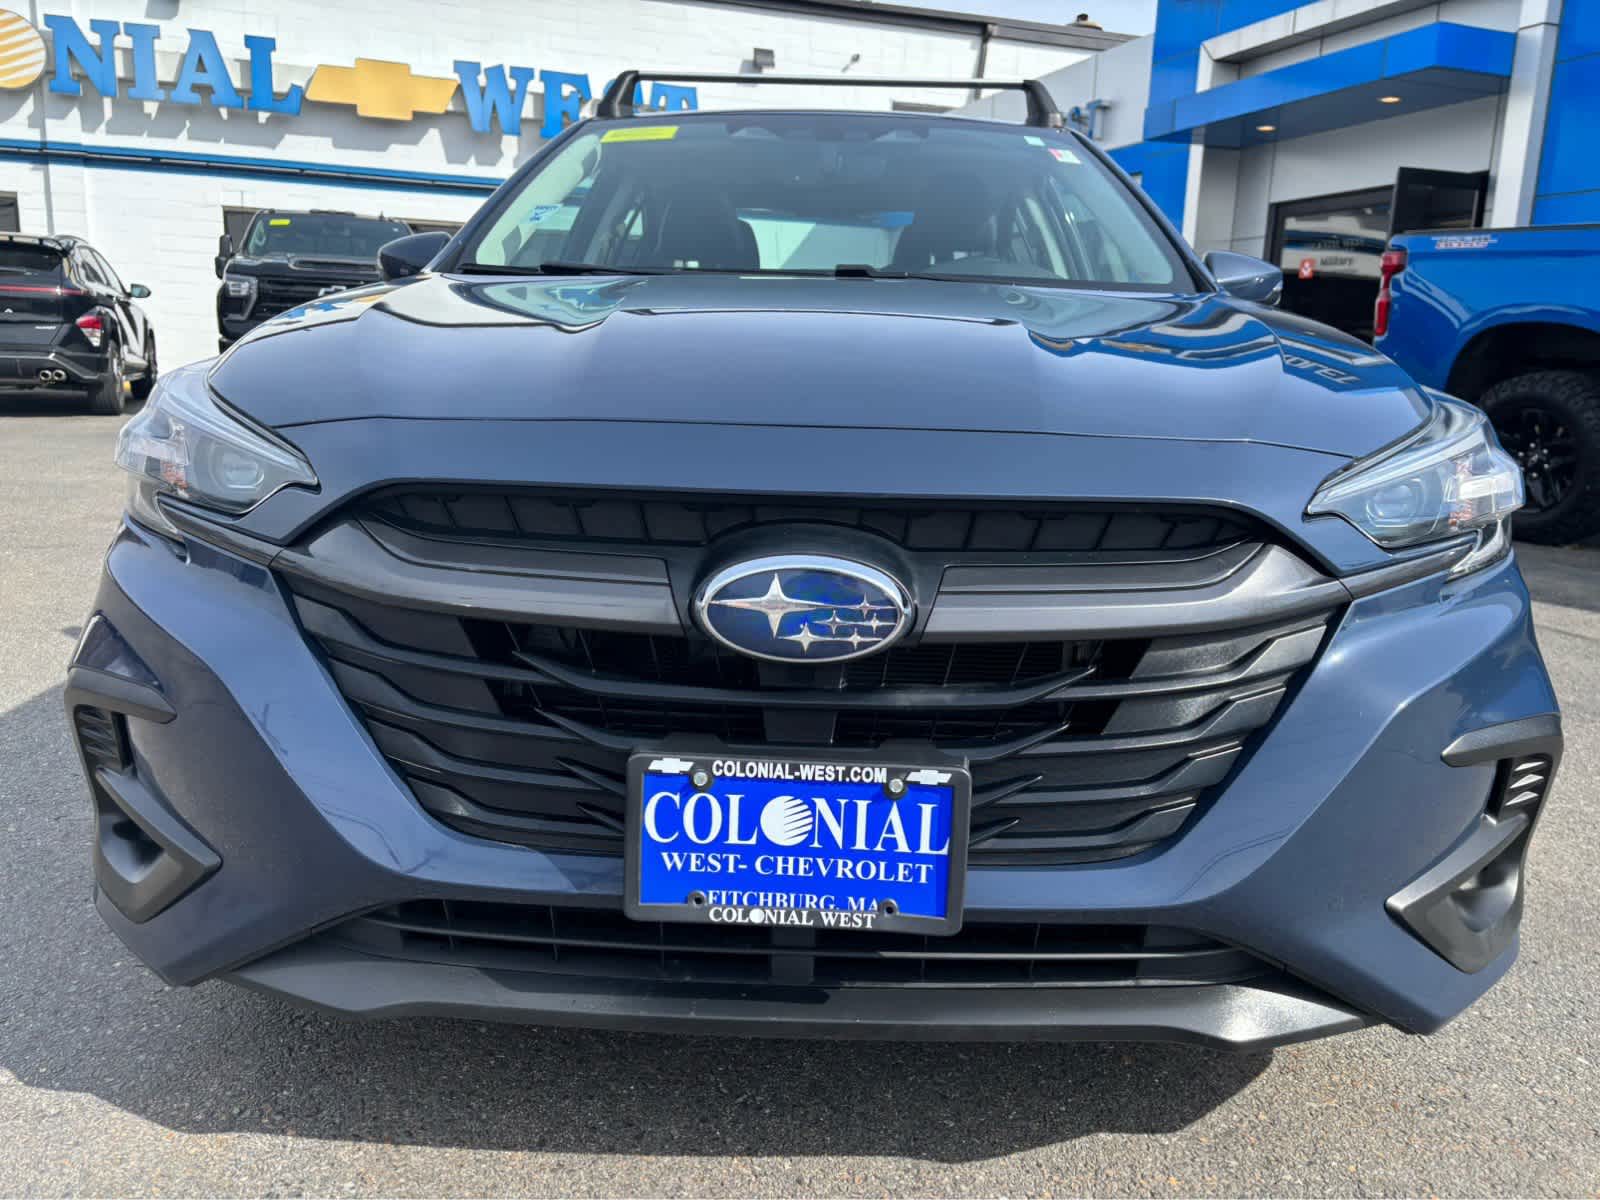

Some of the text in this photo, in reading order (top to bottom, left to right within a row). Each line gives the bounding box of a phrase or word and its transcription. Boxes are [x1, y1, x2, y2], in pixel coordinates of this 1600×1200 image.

[711, 760, 888, 784] COLONIAL-WEST.COM
[755, 855, 933, 883] CHEVROLET
[820, 912, 876, 928] WEST
